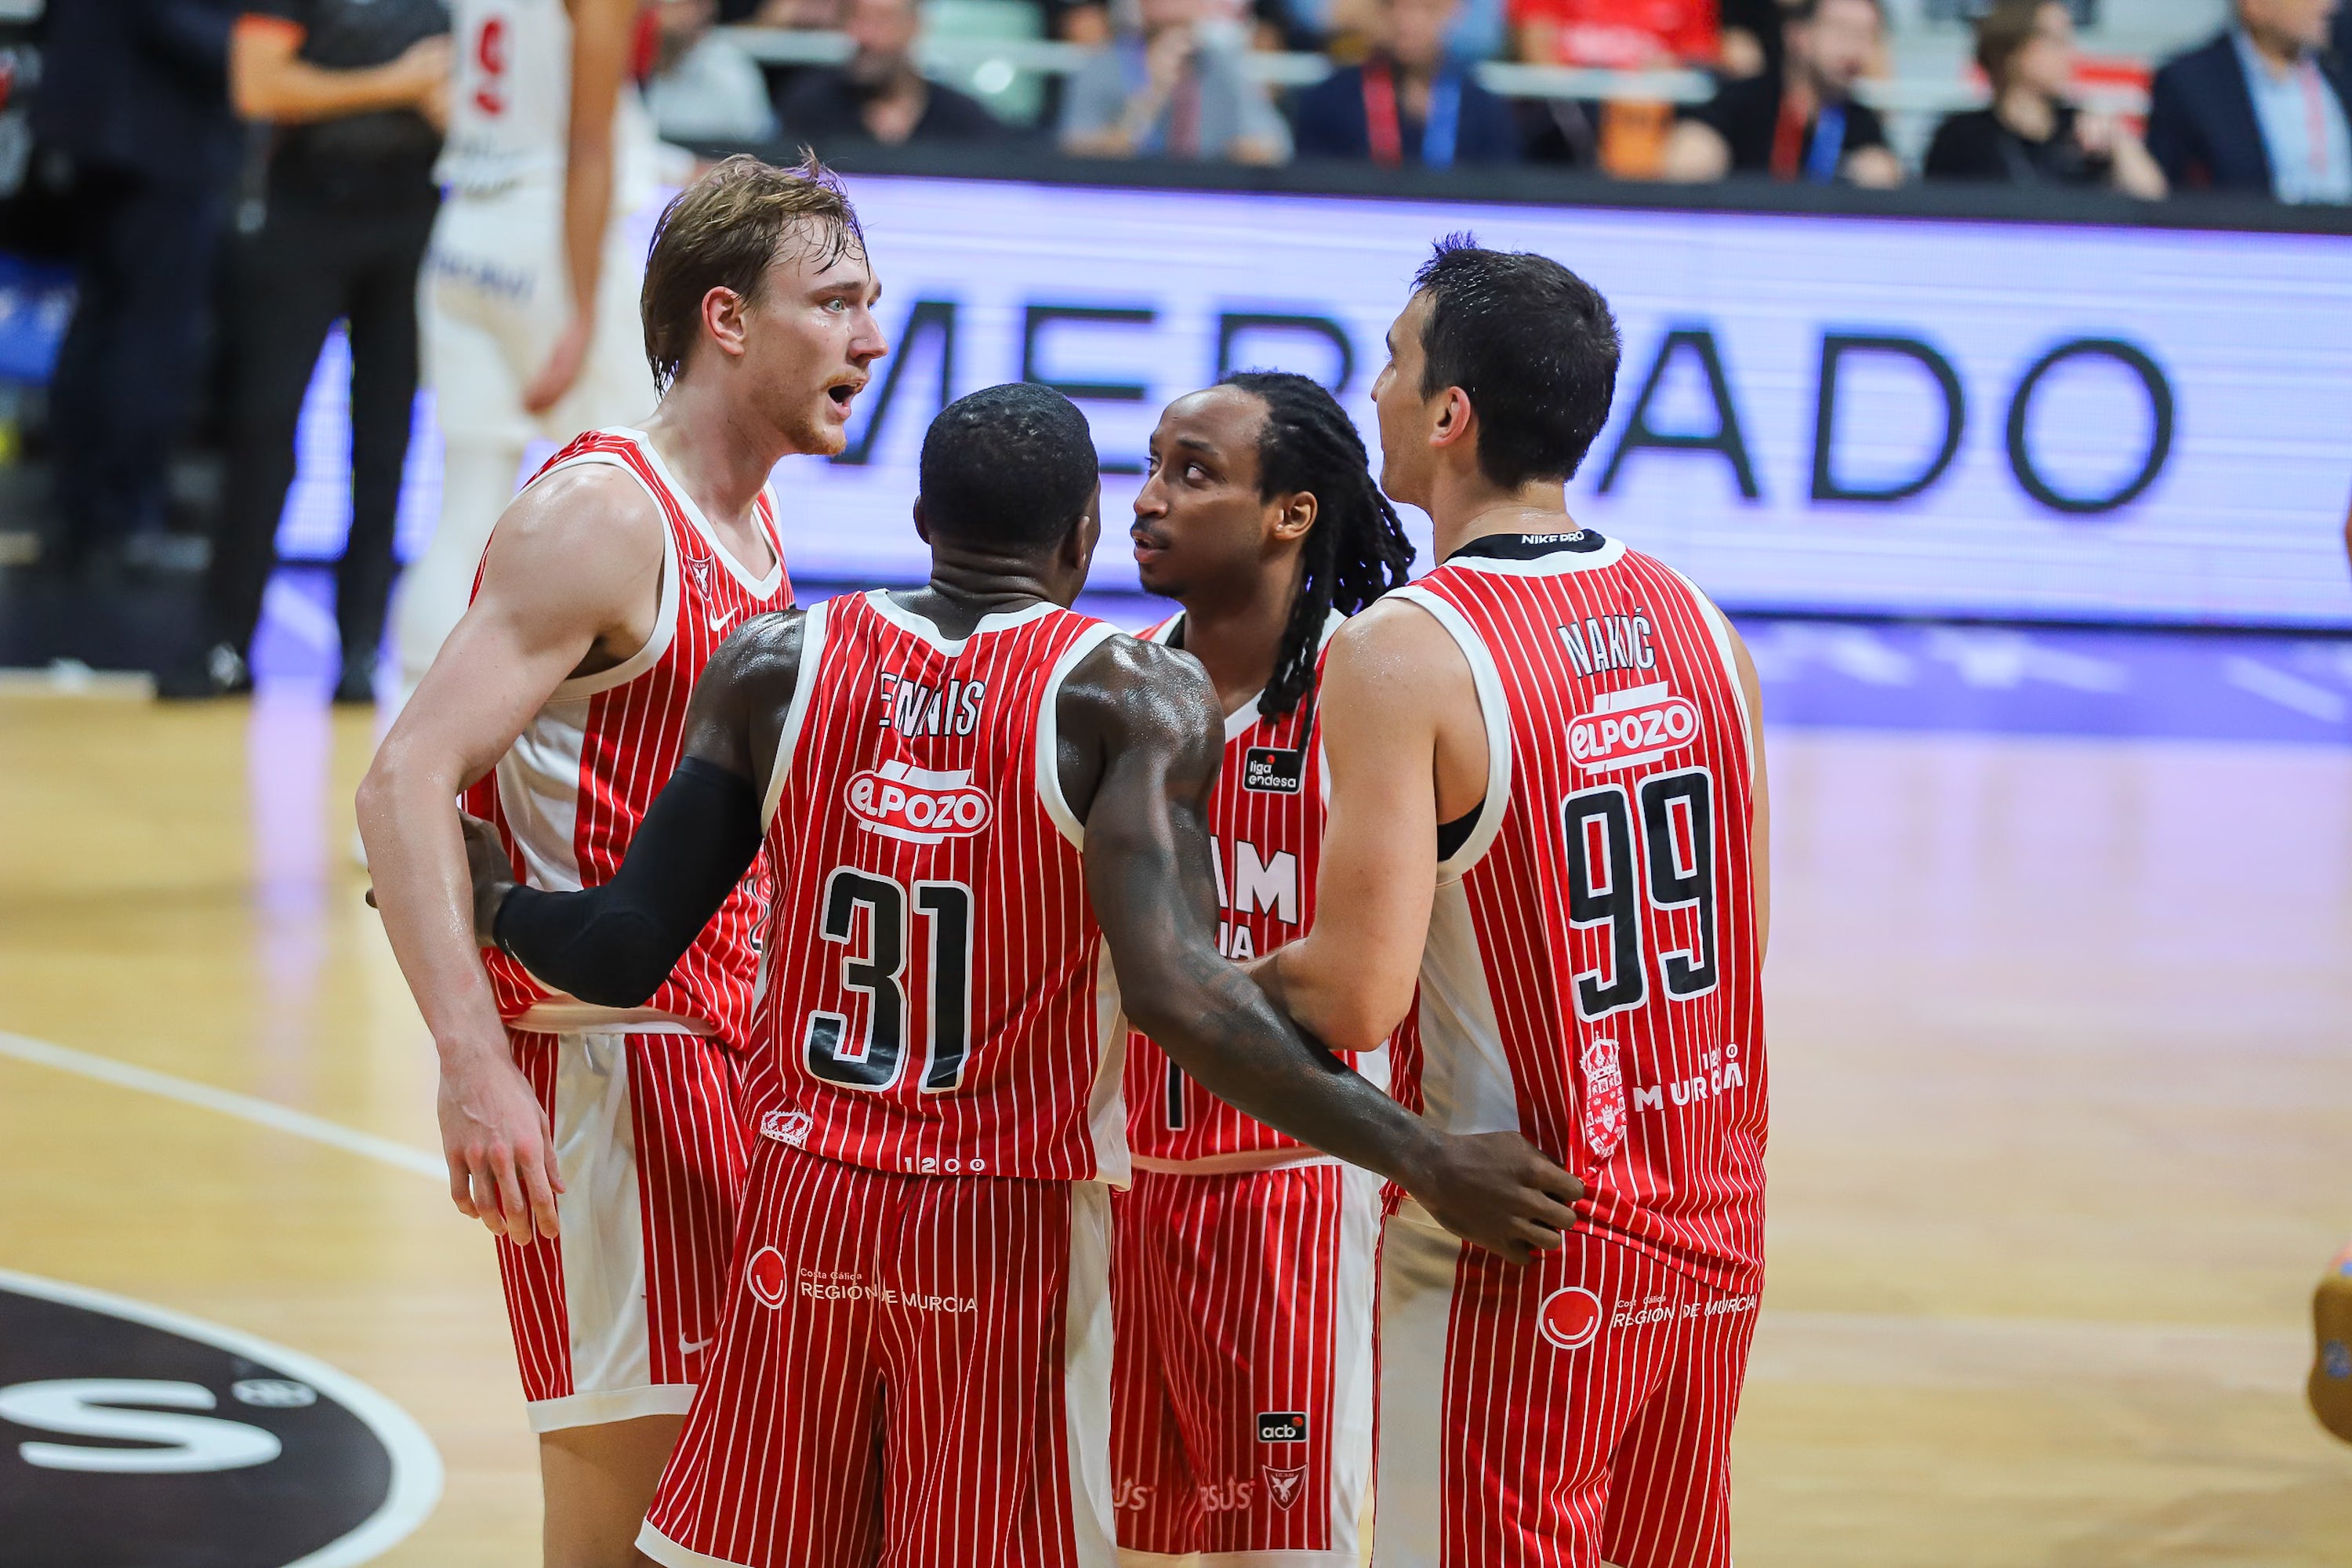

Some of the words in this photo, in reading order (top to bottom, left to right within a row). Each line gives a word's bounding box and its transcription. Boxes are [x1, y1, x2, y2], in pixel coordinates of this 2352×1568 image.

[829, 301, 2174, 514] EADO
[1522, 534, 1559, 544] NIKE
[1559, 530, 1584, 543] PRO
[1557, 607, 1656, 678] NAKIĆ
[1250, 760, 1272, 775] liga
[1248, 773, 1297, 788] endesa
[1561, 765, 1719, 1023] 99
[803, 865, 975, 1094] 31
[1702, 1043, 1738, 1070] 120
[1632, 1062, 1744, 1112] MURCA
[904, 1156, 985, 1174] 1200
[902, 1291, 978, 1313] MURCIA
[1617, 1299, 1637, 1308] Cost
[1704, 1295, 1756, 1317] MURCIA
[1261, 1425, 1296, 1439] acb
